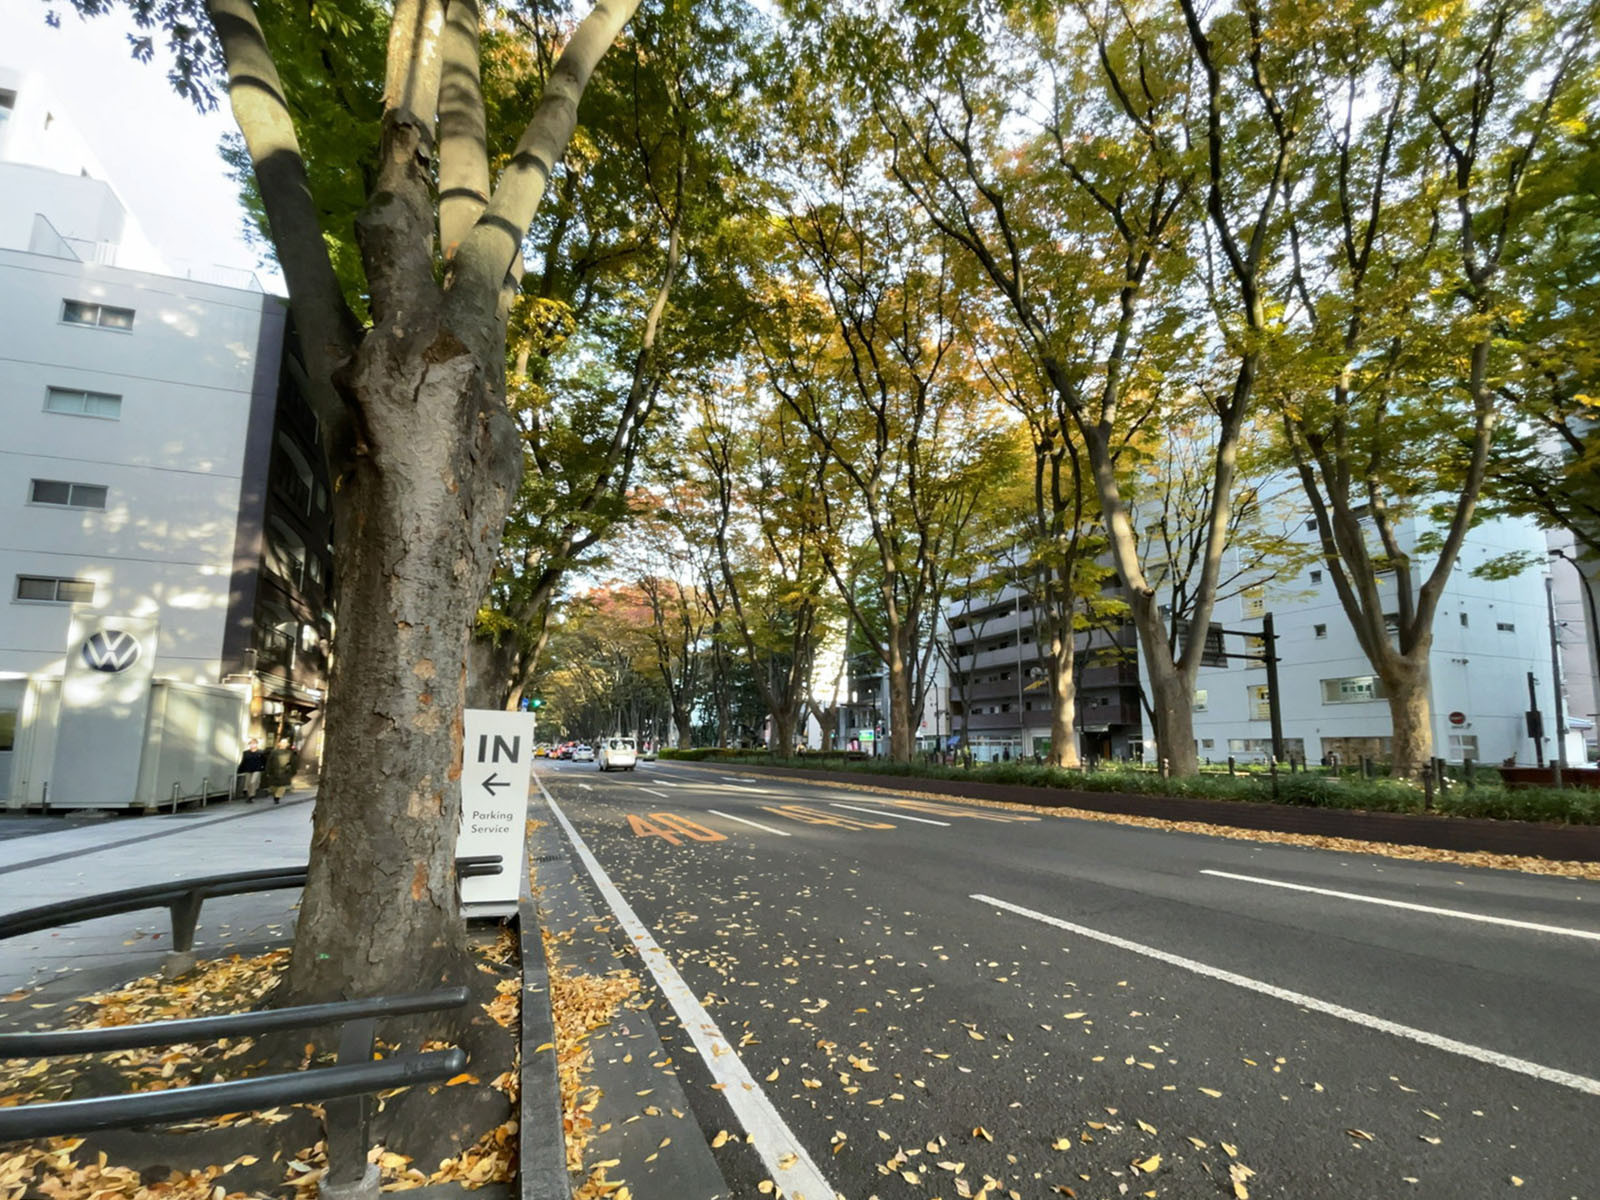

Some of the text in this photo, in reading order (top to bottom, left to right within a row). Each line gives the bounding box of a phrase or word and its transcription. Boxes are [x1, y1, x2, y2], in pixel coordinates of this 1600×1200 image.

[478, 734, 520, 763] IN
[472, 810, 513, 821] Parking
[471, 824, 510, 833] Service
[625, 812, 728, 846] 40
